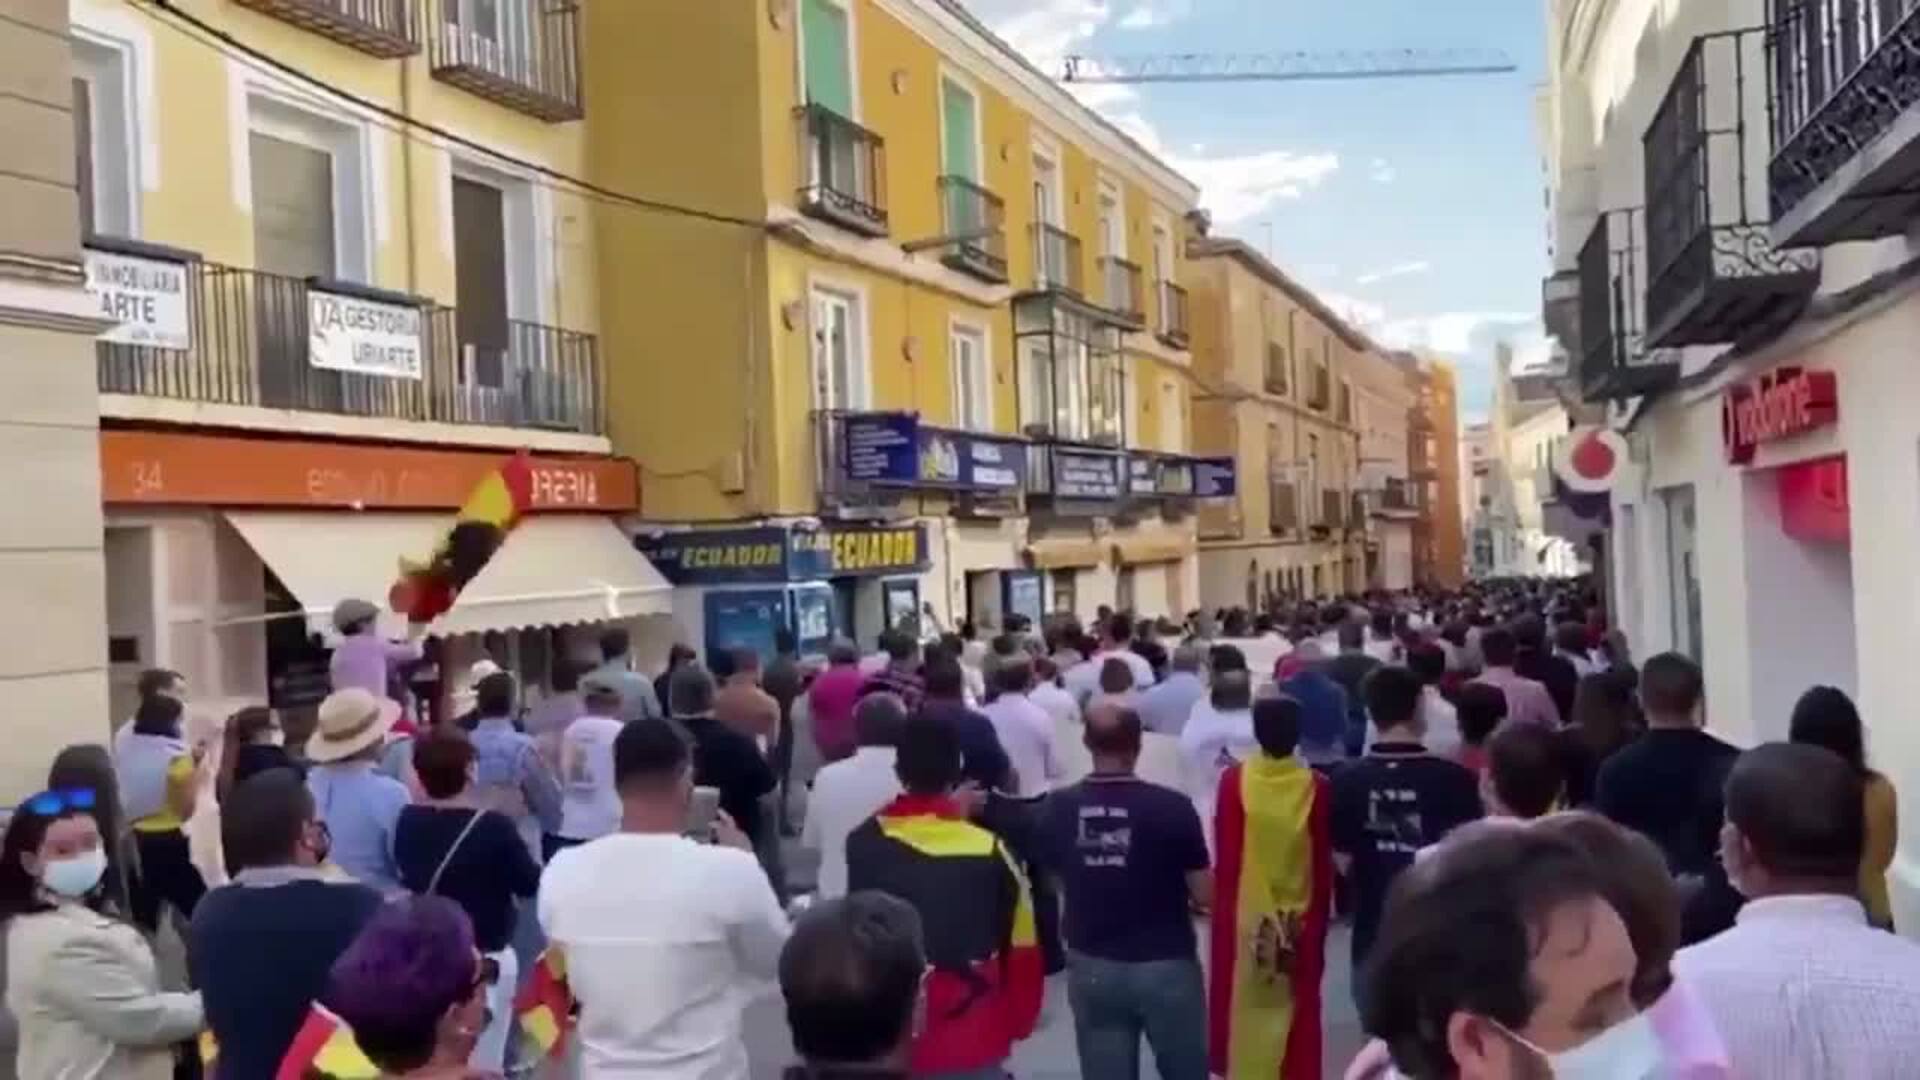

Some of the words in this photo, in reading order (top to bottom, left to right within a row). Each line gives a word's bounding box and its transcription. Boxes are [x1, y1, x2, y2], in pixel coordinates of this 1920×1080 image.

[102, 291, 156, 324] ARTE
[347, 303, 419, 336] GESTORIA
[351, 341, 417, 371] URIARTE
[131, 461, 163, 496] 34
[682, 543, 781, 569] ECUADOR
[832, 529, 916, 570] ECUADOR
